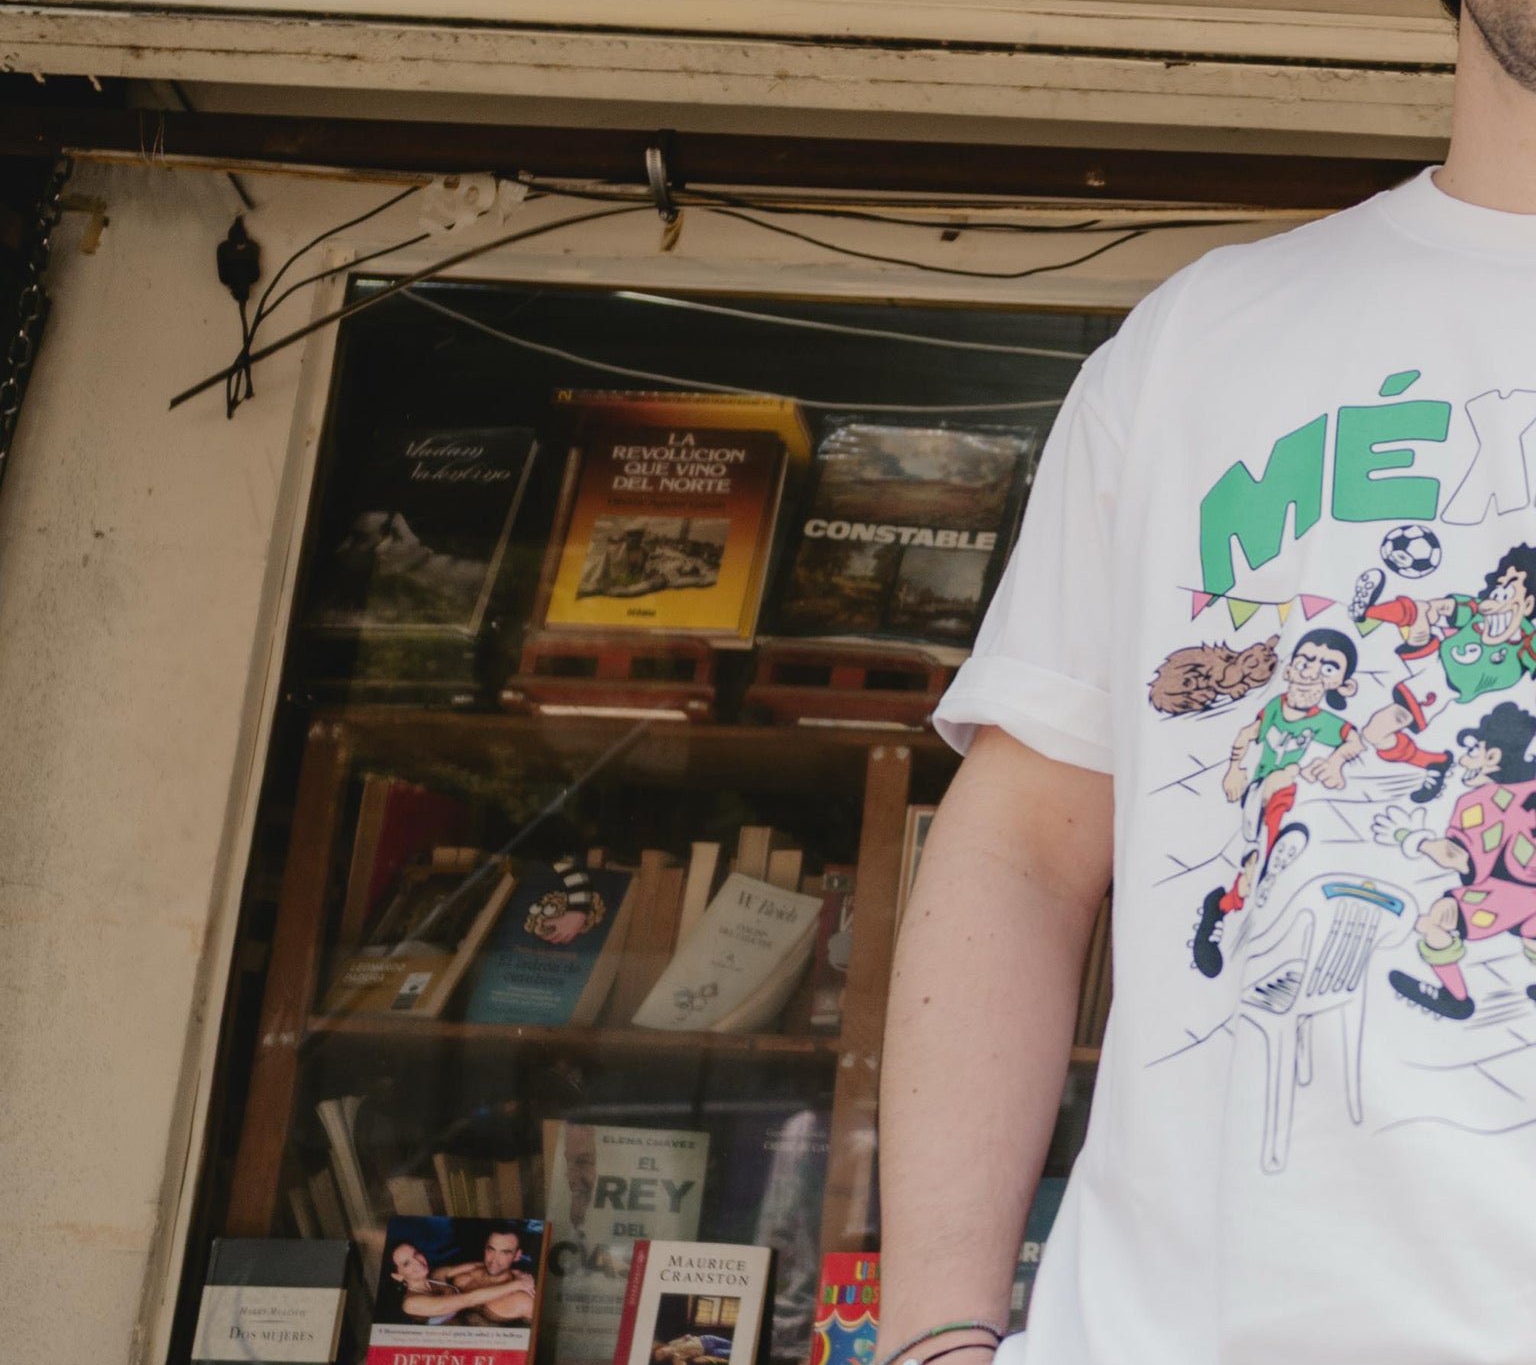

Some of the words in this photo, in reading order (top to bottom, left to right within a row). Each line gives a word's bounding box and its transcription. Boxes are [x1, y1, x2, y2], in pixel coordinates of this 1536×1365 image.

[668, 433, 696, 446] LA
[611, 445, 746, 464] REVOLUCION
[623, 461, 669, 477] QUE
[675, 462, 728, 478] VINO
[611, 476, 654, 493] DEL
[659, 477, 732, 495] NORTE
[803, 518, 998, 551] CONSTABLE
[637, 1155, 659, 1171] EL
[594, 1174, 696, 1214] REY
[611, 1221, 647, 1237] DEL
[668, 1254, 748, 1271] MAURICE
[855, 1259, 880, 1282] LIB
[659, 1268, 750, 1287] CRANSTON
